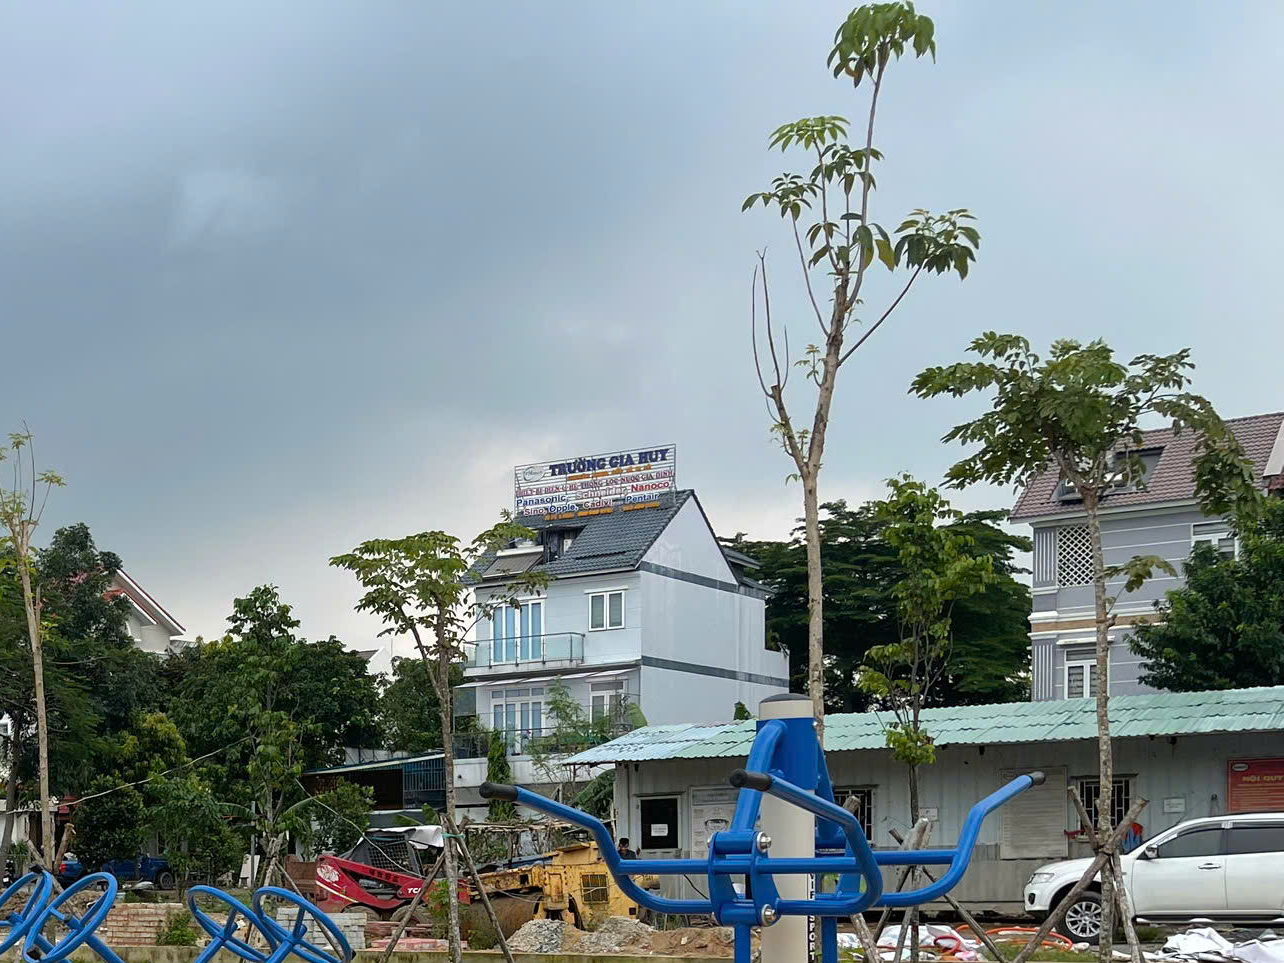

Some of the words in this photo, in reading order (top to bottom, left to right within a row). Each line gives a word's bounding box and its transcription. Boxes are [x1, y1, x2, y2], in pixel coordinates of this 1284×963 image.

[549, 457, 607, 476] TRƯỜNG
[609, 453, 635, 467] GIA
[638, 449, 670, 464] HUY
[626, 492, 659, 503] Pentair
